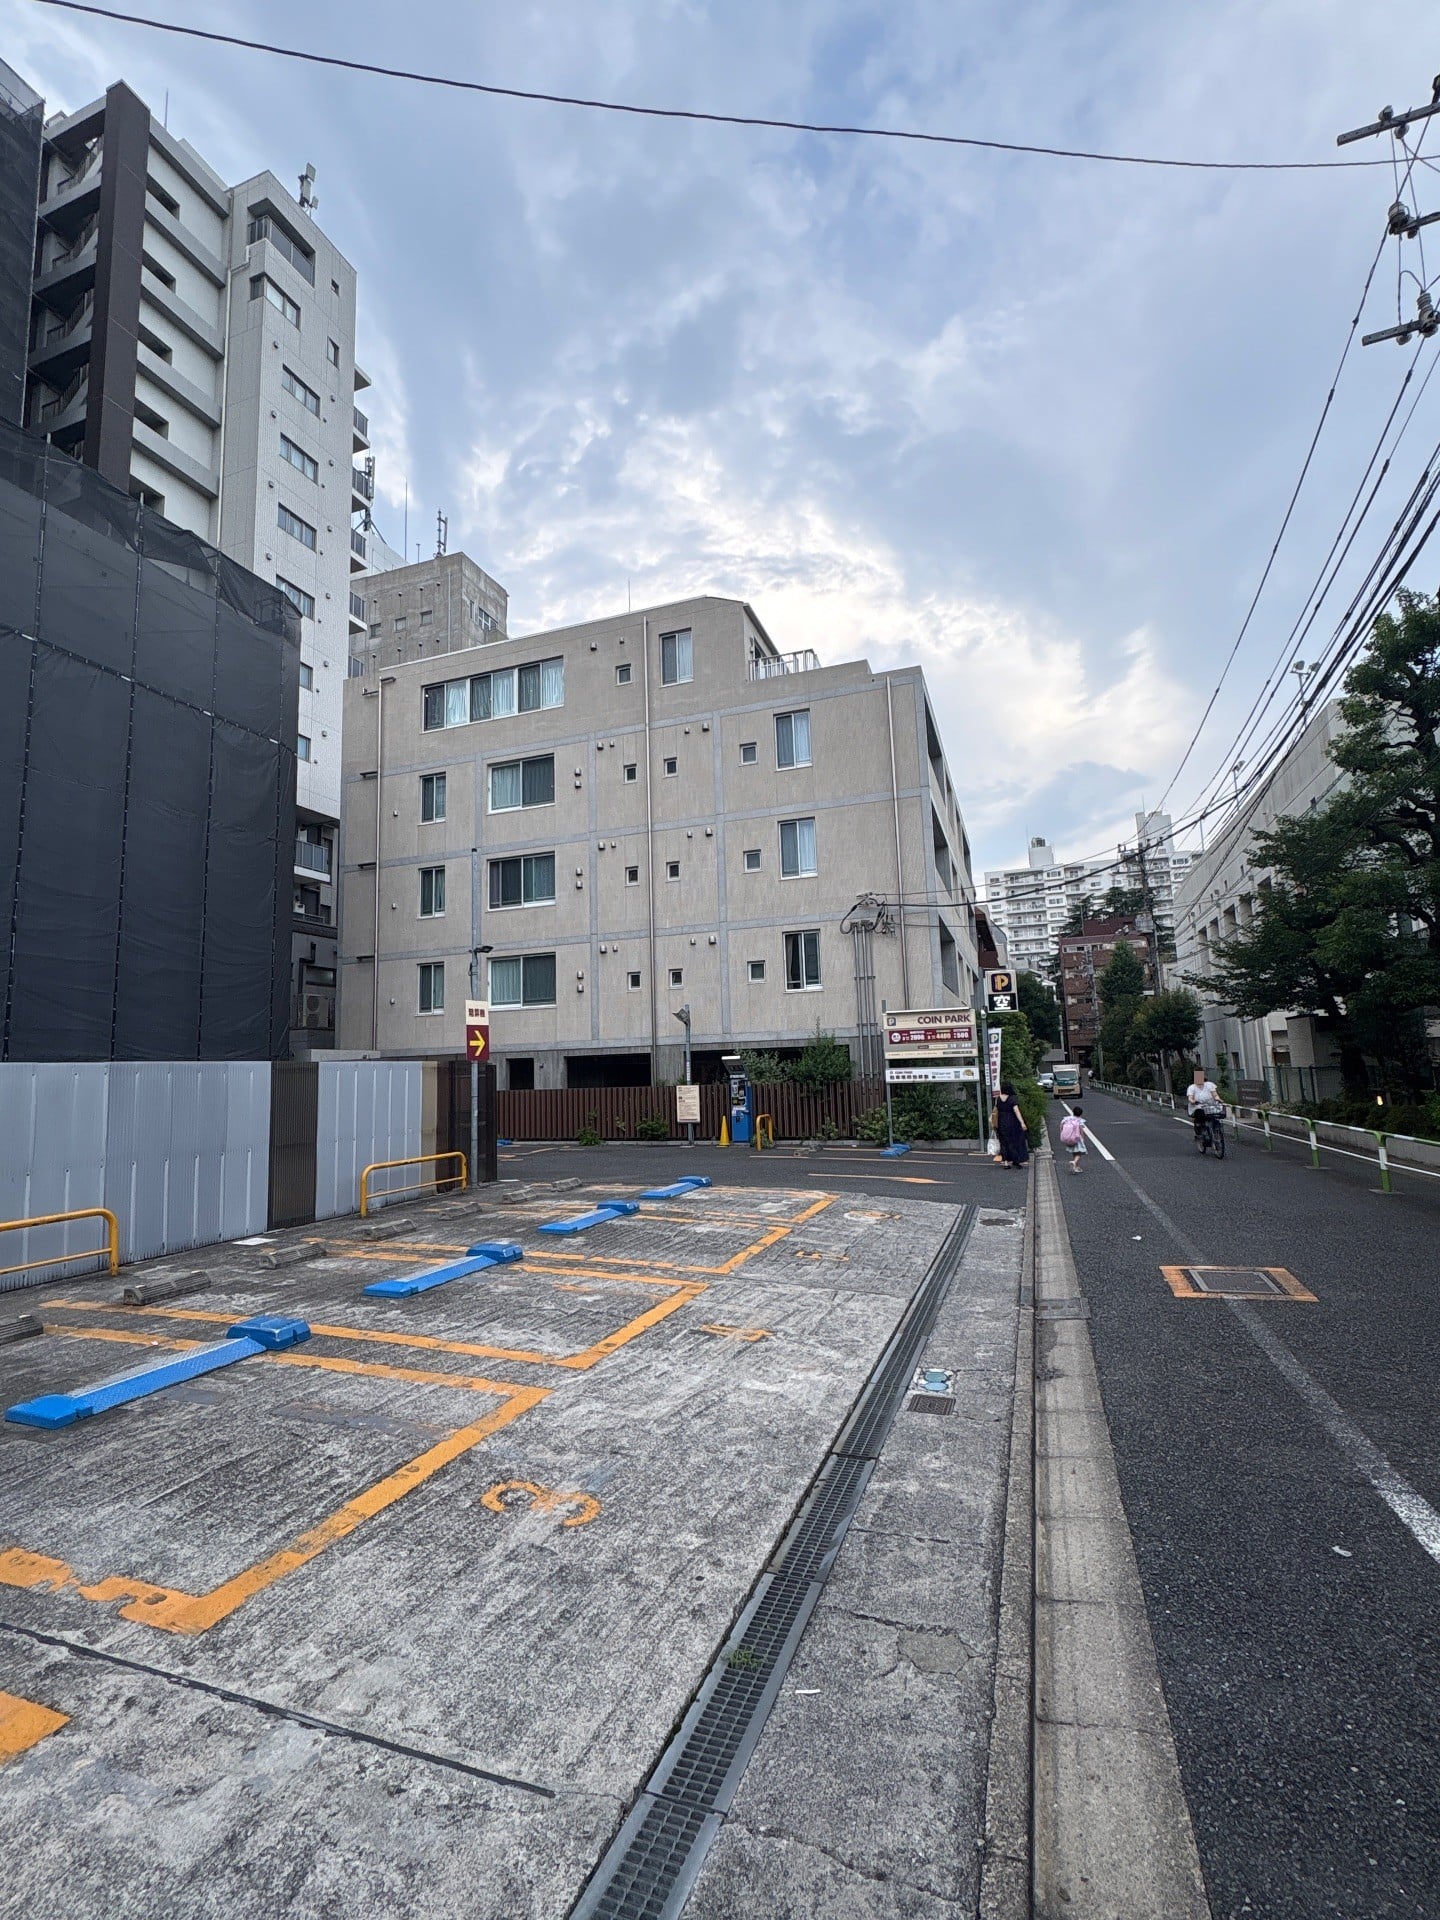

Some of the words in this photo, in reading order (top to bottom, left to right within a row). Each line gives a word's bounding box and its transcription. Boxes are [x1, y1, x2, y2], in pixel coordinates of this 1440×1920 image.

[994, 974, 1009, 991] P
[993, 995, 1011, 1011] 空
[917, 1015, 942, 1025] COIN
[944, 1013, 972, 1024] PARK
